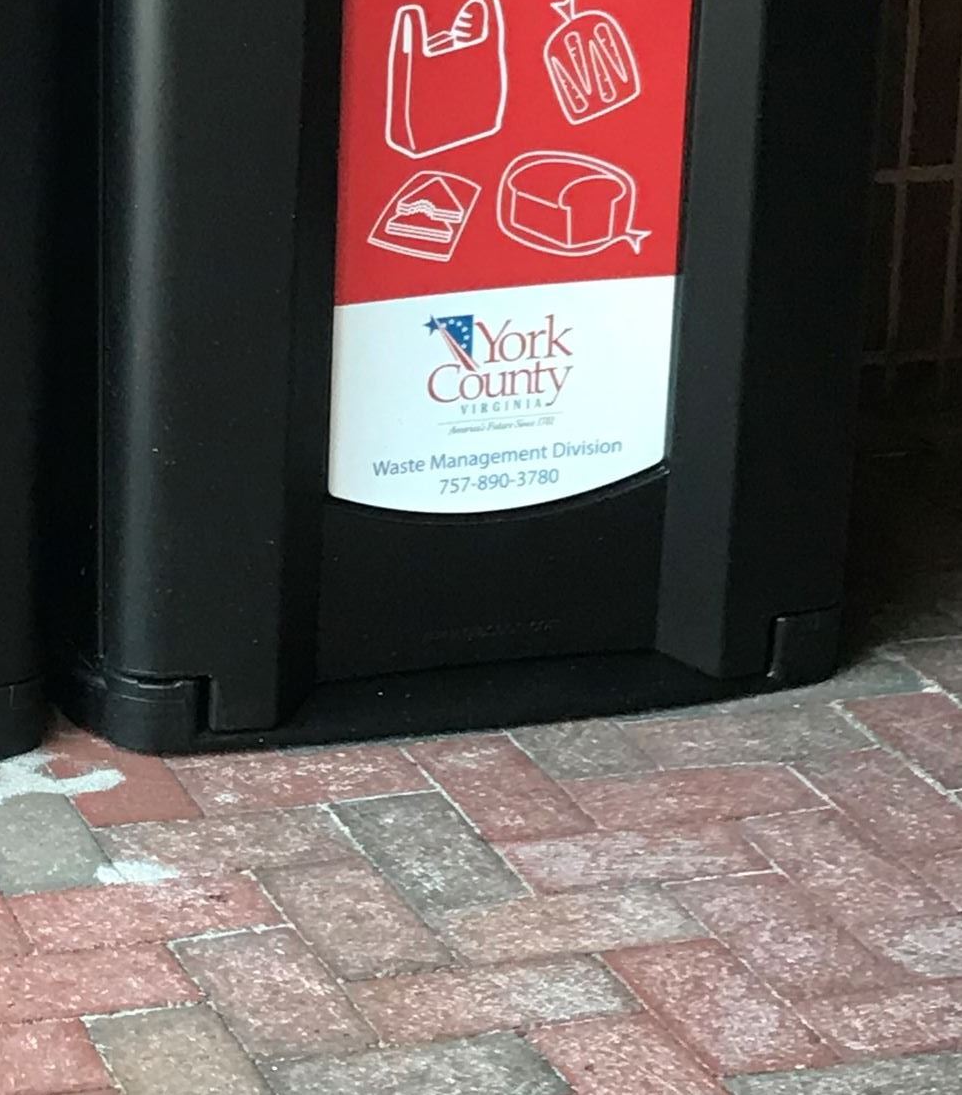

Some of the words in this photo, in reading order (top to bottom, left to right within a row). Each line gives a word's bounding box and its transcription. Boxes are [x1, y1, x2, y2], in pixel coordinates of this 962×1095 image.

[475, 314, 573, 363] York
[428, 361, 573, 407] County
[461, 399, 542, 414] VIRGINIA
[372, 460, 425, 477] Waste
[430, 445, 547, 471] Management
[552, 439, 622, 458] Division
[439, 468, 560, 495] 757-890-3780
